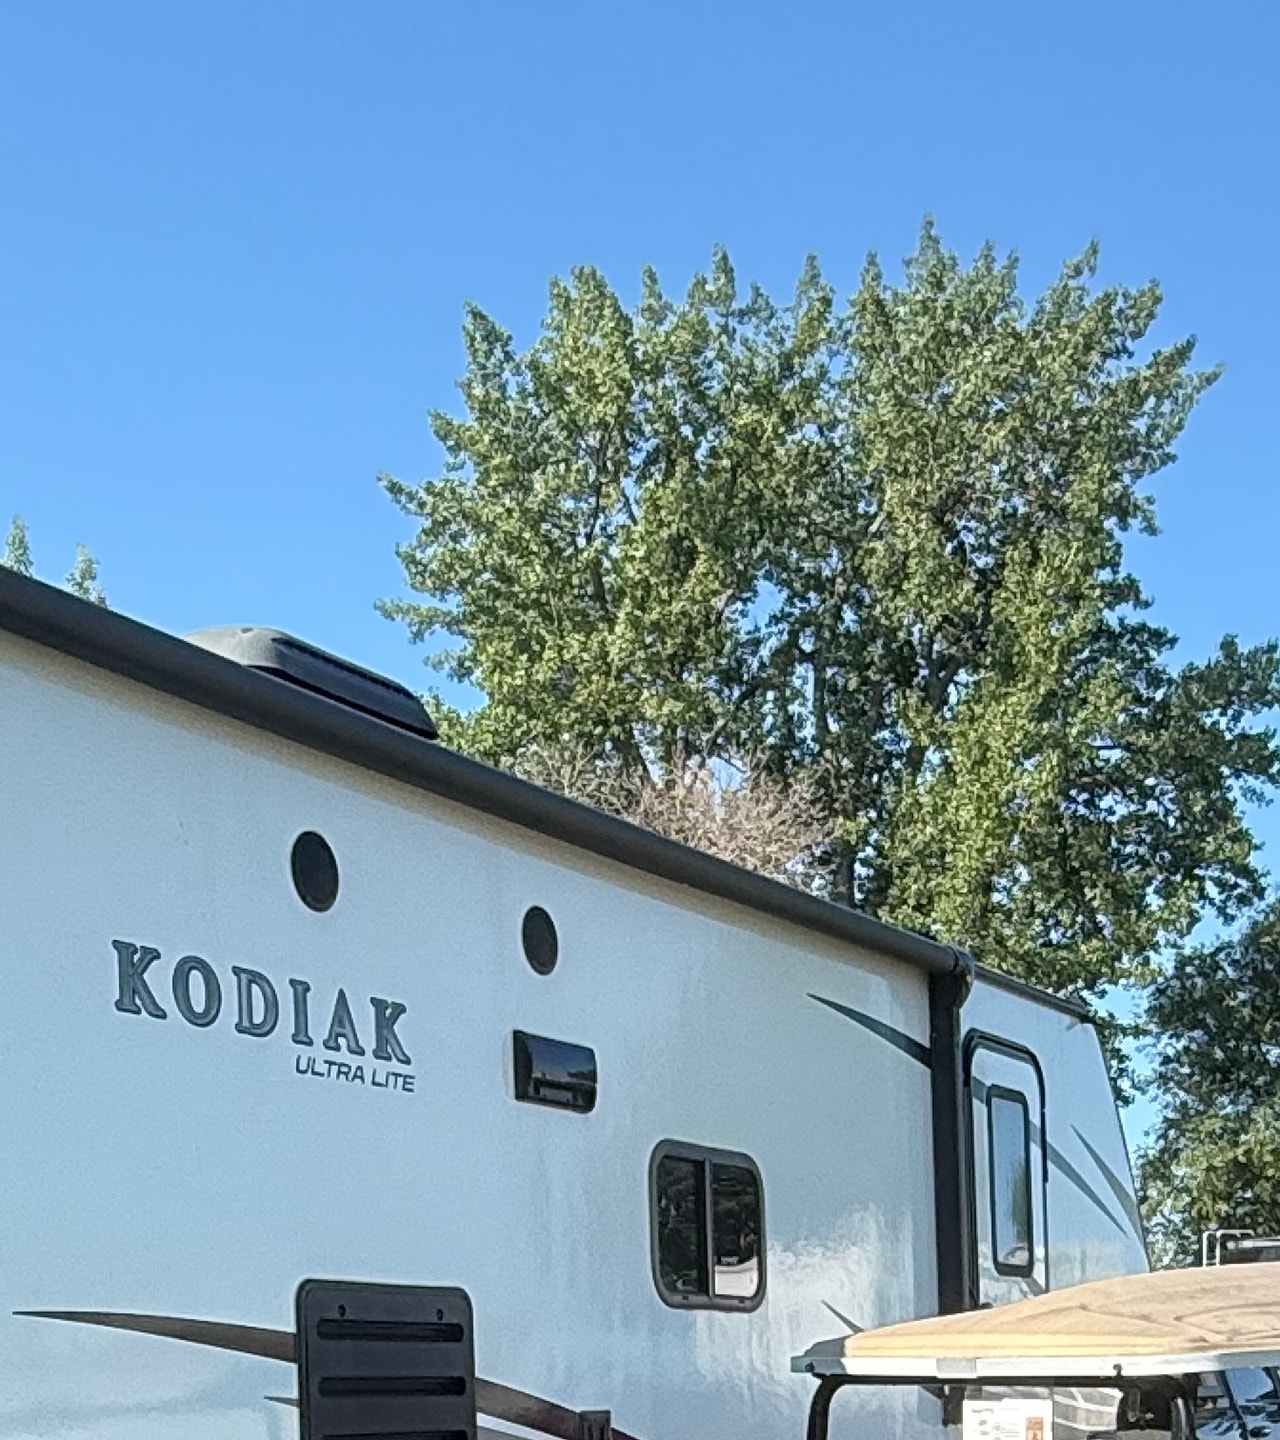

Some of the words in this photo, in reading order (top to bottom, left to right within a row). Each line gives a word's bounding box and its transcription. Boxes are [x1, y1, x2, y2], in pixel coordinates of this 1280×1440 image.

[111, 938, 412, 1066] KODIAK
[295, 1053, 366, 1085] ULTRA
[370, 1069, 417, 1093] LITE
